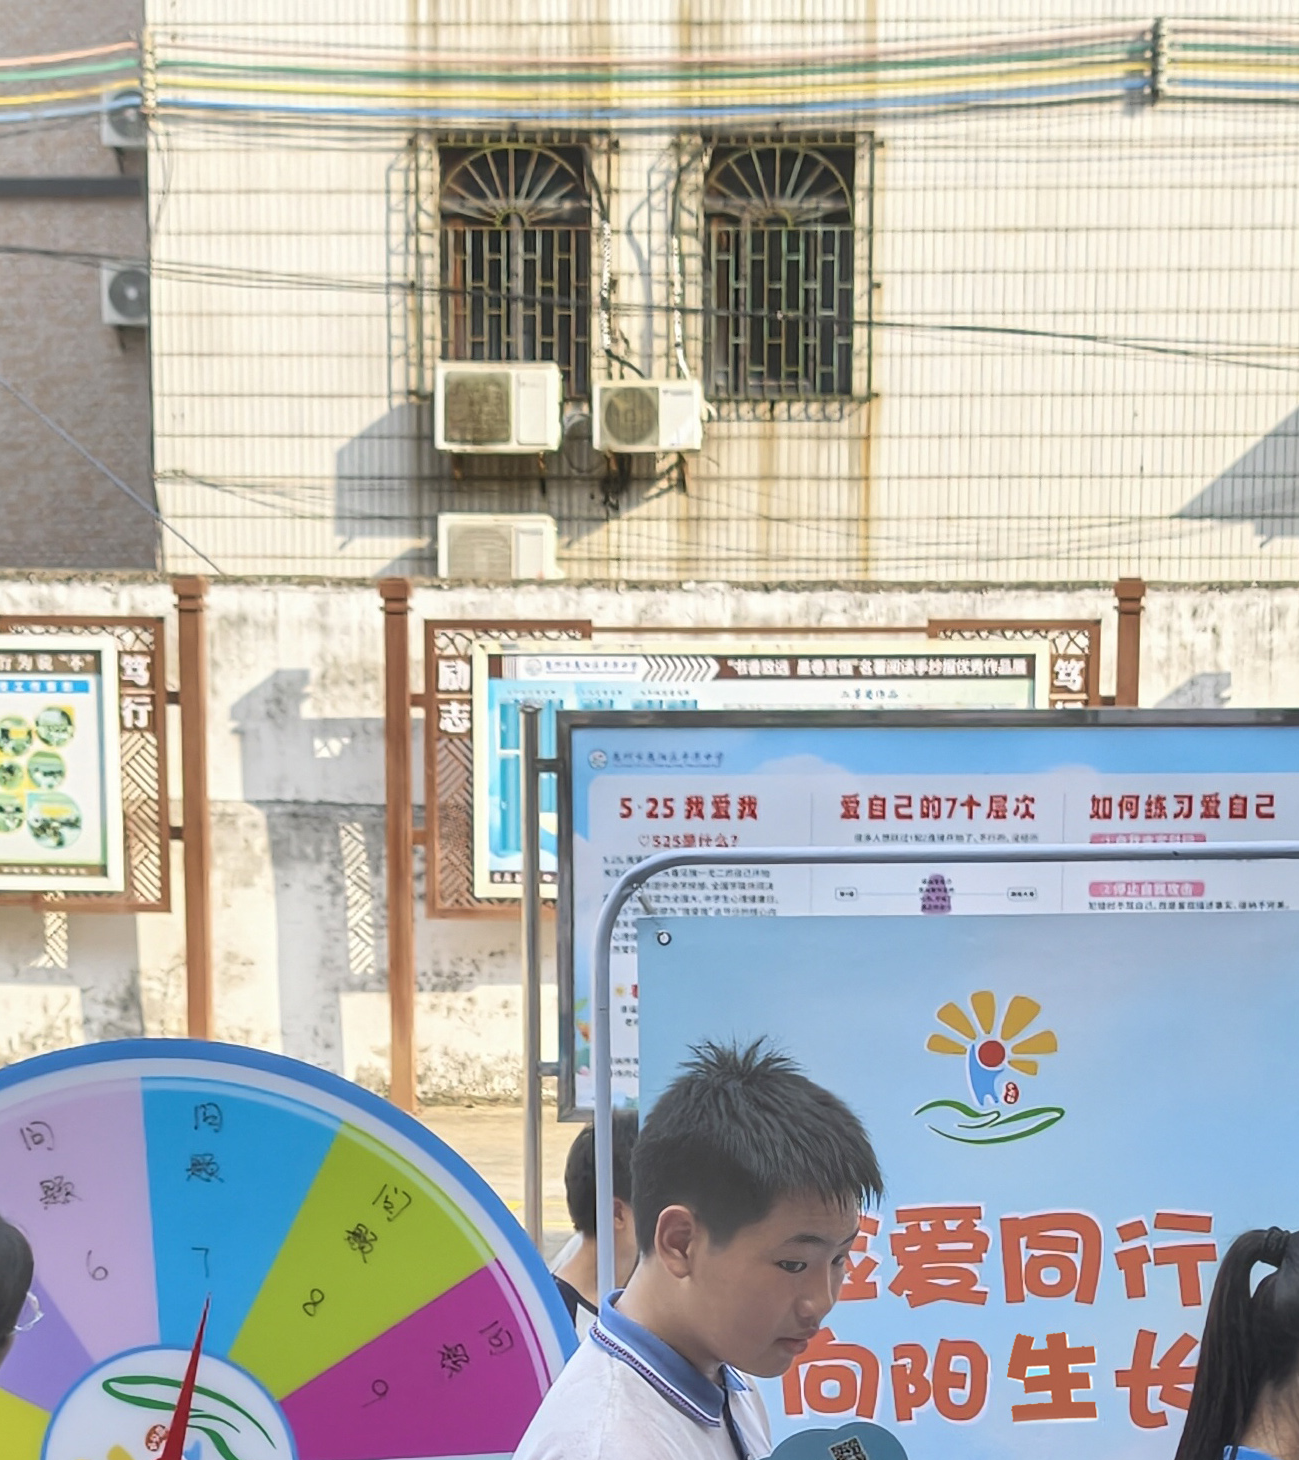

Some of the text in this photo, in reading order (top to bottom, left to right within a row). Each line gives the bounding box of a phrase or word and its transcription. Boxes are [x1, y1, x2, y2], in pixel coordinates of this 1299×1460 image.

[120, 653, 154, 727] 笃行
[438, 658, 471, 733] 励志
[684, 793, 758, 821] 我爱我
[840, 793, 1036, 820] 爱自己的7个层次
[1089, 793, 1276, 820] 如何练习爱自己
[782, 1328, 1199, 1430] 向阳生长
